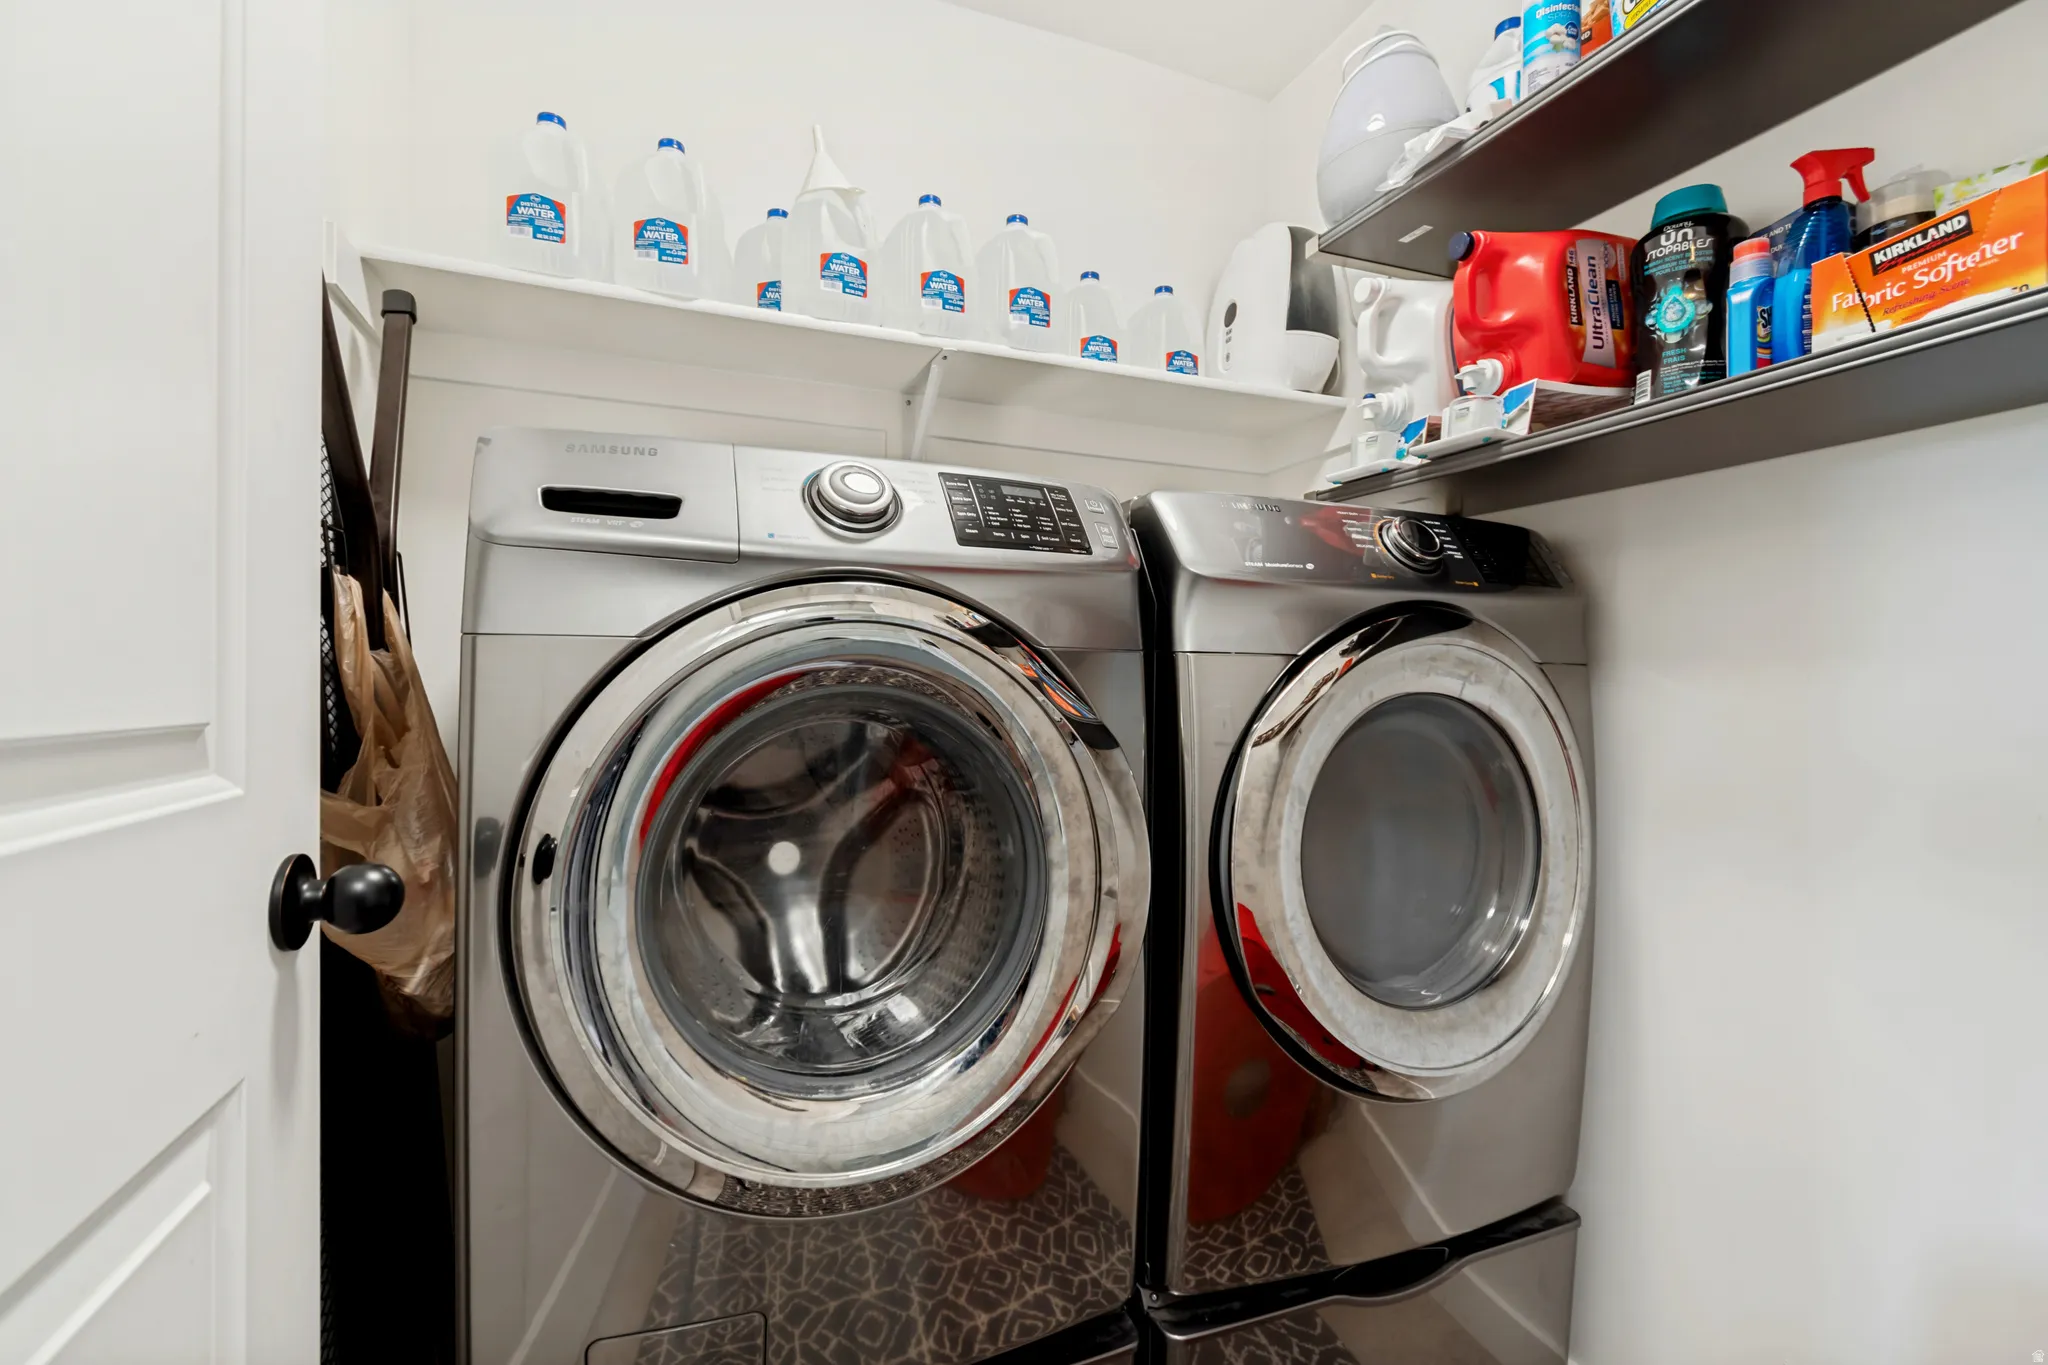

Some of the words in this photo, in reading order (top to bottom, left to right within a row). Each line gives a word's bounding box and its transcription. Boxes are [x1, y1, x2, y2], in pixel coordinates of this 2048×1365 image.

[1536, 3, 1580, 18] Disinfecta
[1548, 12, 1572, 22] SPRA
[516, 206, 555, 219] WATER
[1663, 221, 1694, 231] Downy
[643, 230, 678, 241] WATER
[1874, 216, 1968, 265] KIRKLAND
[1902, 250, 1947, 273] PREMIUM
[830, 263, 860, 276] WATER
[1832, 281, 1906, 312] Fabric
[1914, 232, 2024, 289] Softener
[930, 281, 958, 292] WATER
[1567, 268, 1578, 323] KIRKLAND
[1017, 297, 1044, 307] WATER
[1588, 256, 1604, 350] UltraClean
[1662, 348, 1686, 357] FRESH
[1664, 355, 1685, 364] FRAIS
[565, 444, 658, 456] SAMSUNG
